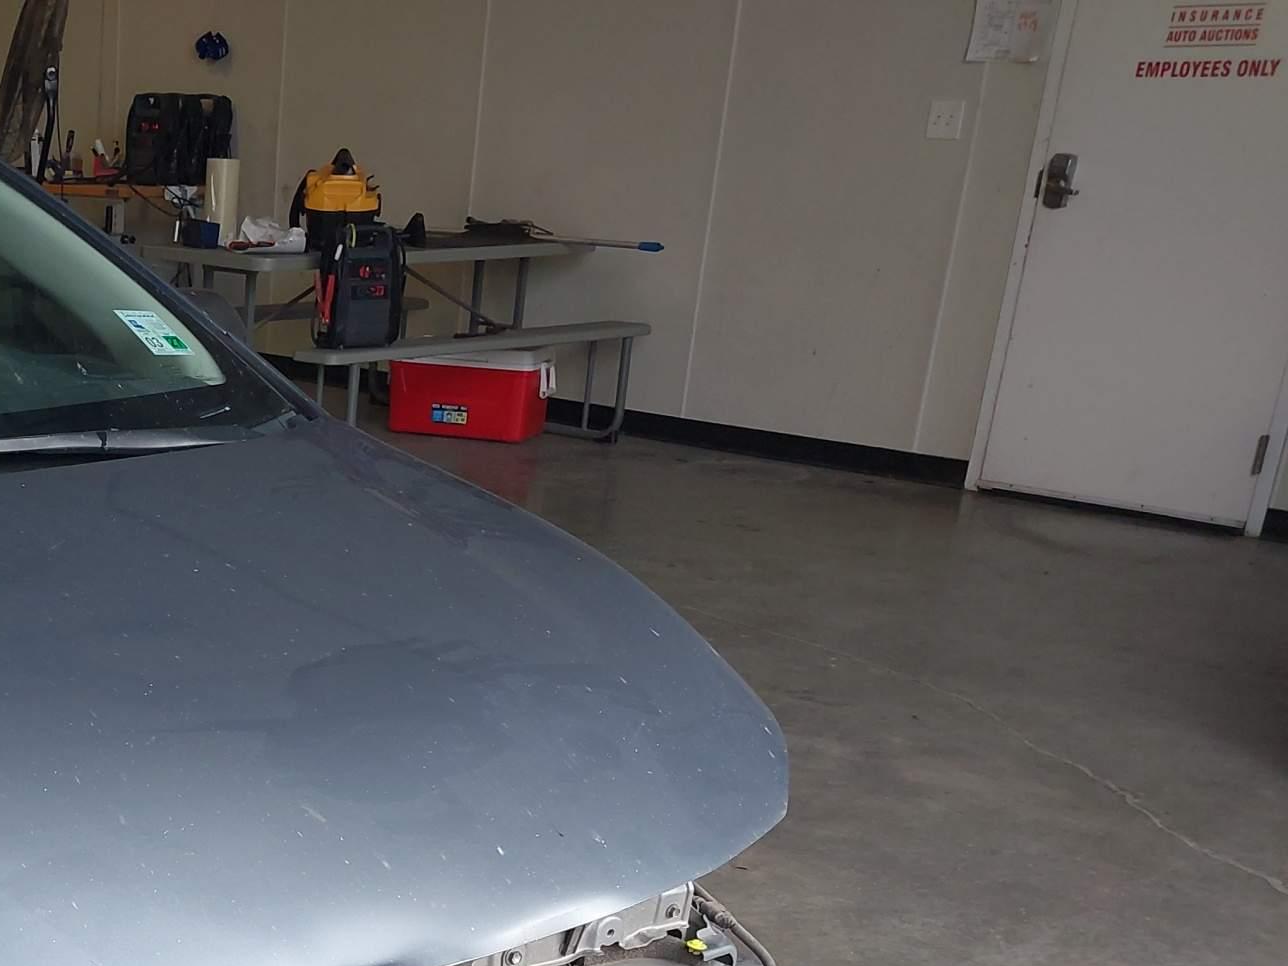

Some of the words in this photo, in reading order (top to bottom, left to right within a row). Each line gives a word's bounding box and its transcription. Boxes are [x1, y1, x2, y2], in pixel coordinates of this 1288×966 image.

[1170, 8, 1265, 23] INSURANCE
[1166, 30, 1197, 43] AUTO
[1199, 28, 1260, 42] AUCTIONS
[1135, 59, 1232, 78] EMPLOYEES
[1236, 58, 1281, 78] ONLY
